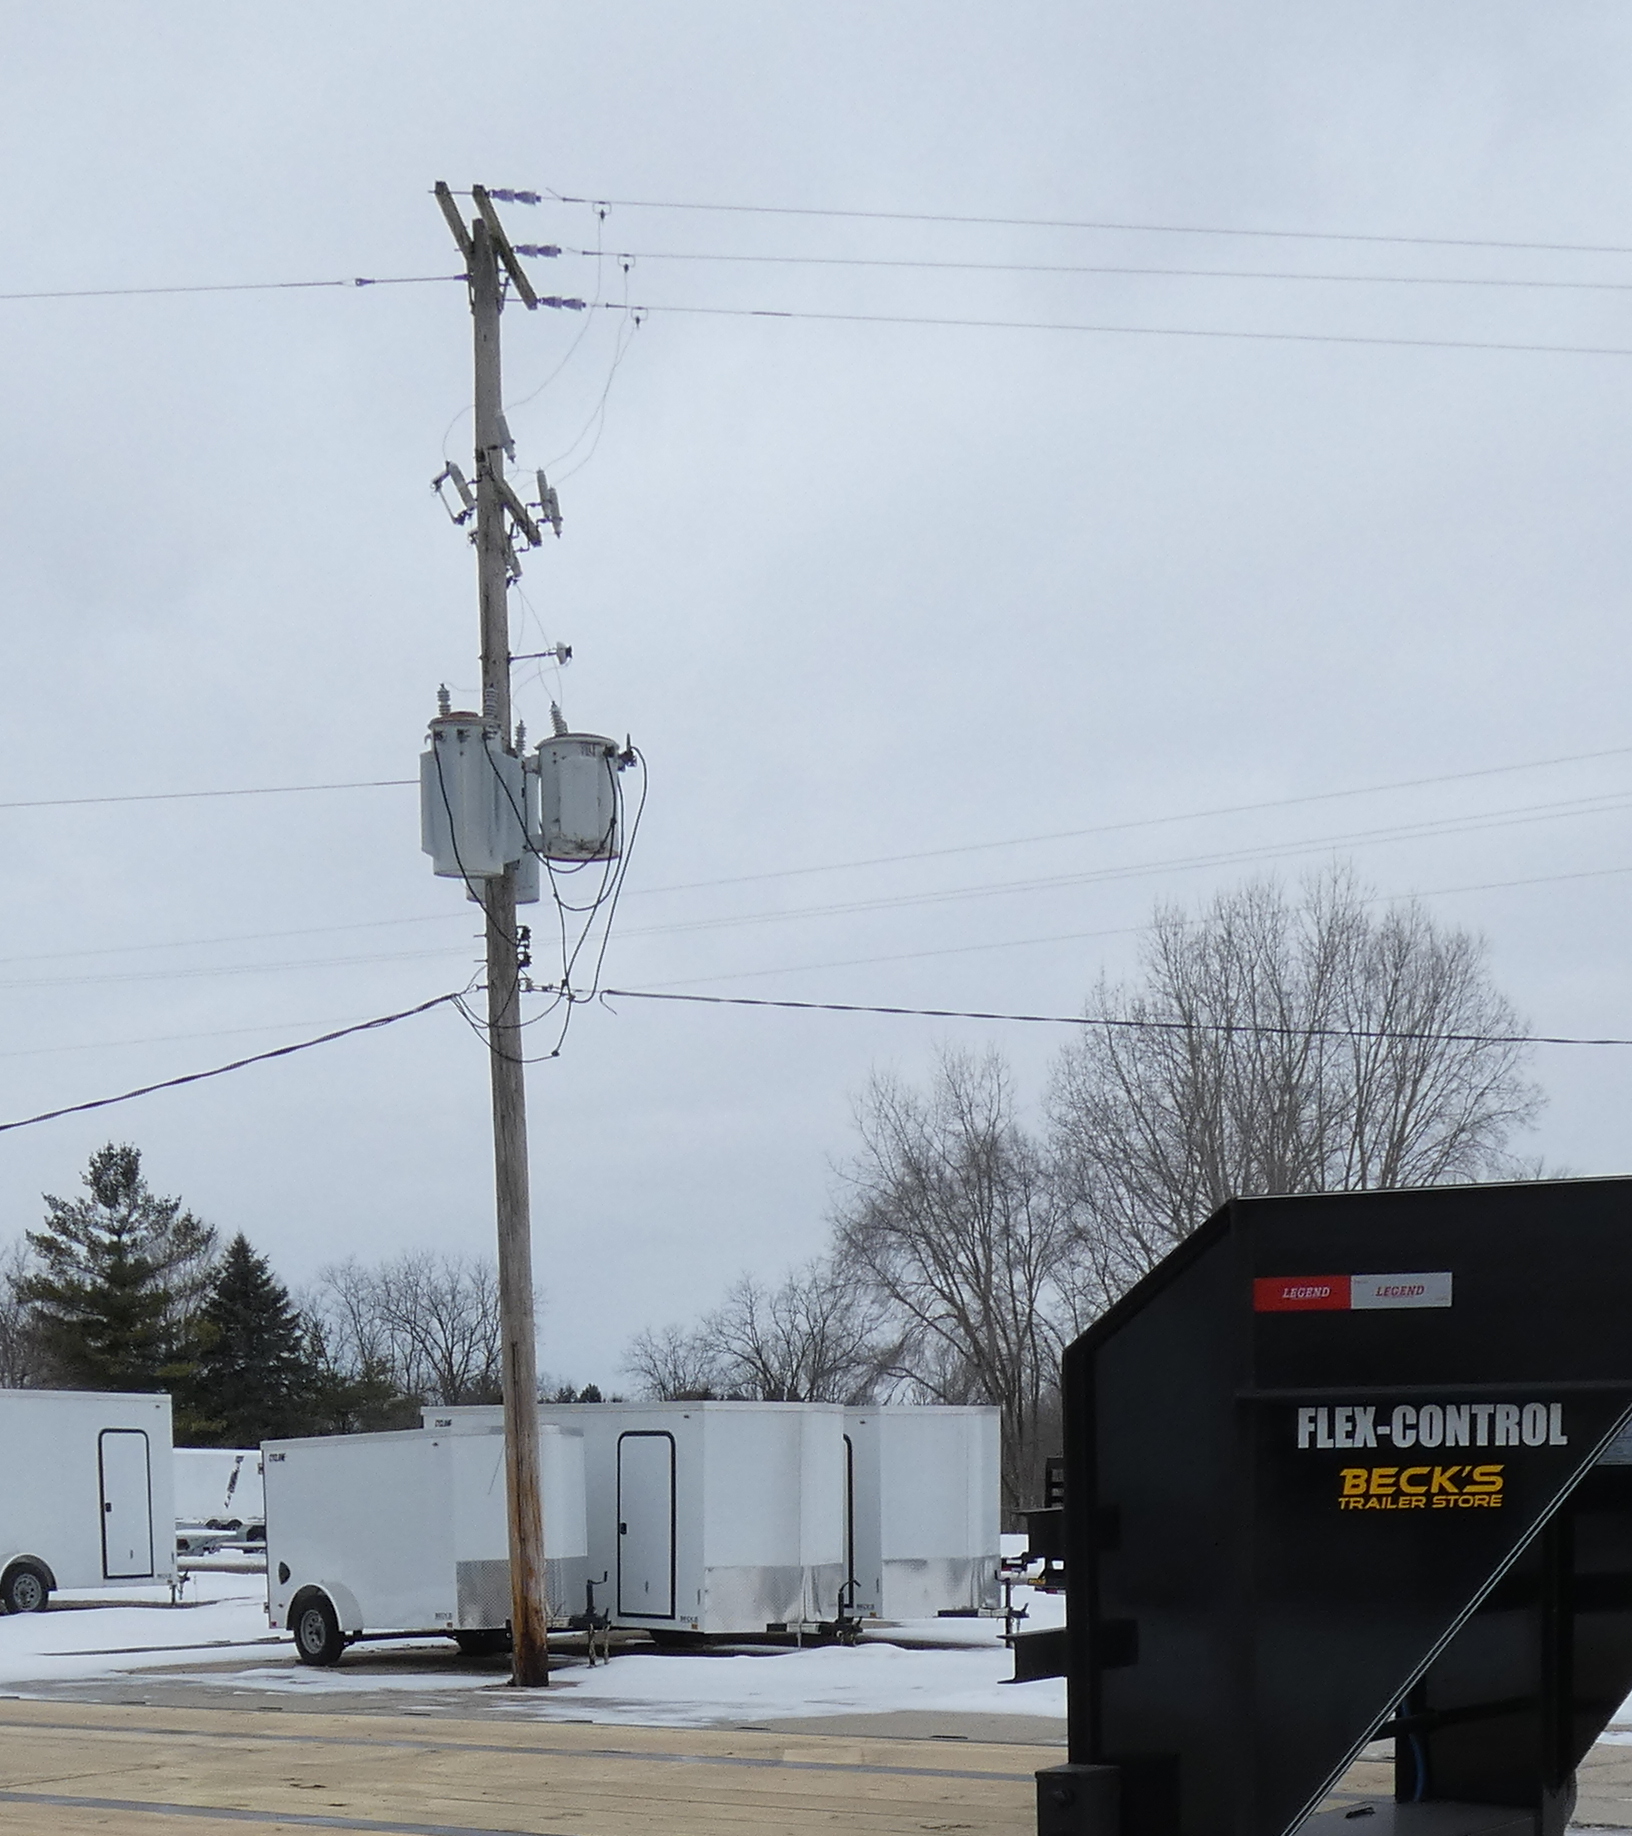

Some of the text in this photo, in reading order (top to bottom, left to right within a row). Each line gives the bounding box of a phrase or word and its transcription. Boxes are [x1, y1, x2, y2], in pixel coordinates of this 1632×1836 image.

[1282, 1285, 1425, 1298] LEGEND LEGEND
[1297, 1403, 1568, 1448] FLEX-CONTROL
[1339, 1464, 1505, 1495] BECK'S
[1338, 1494, 1503, 1510] TRAILER STORE
